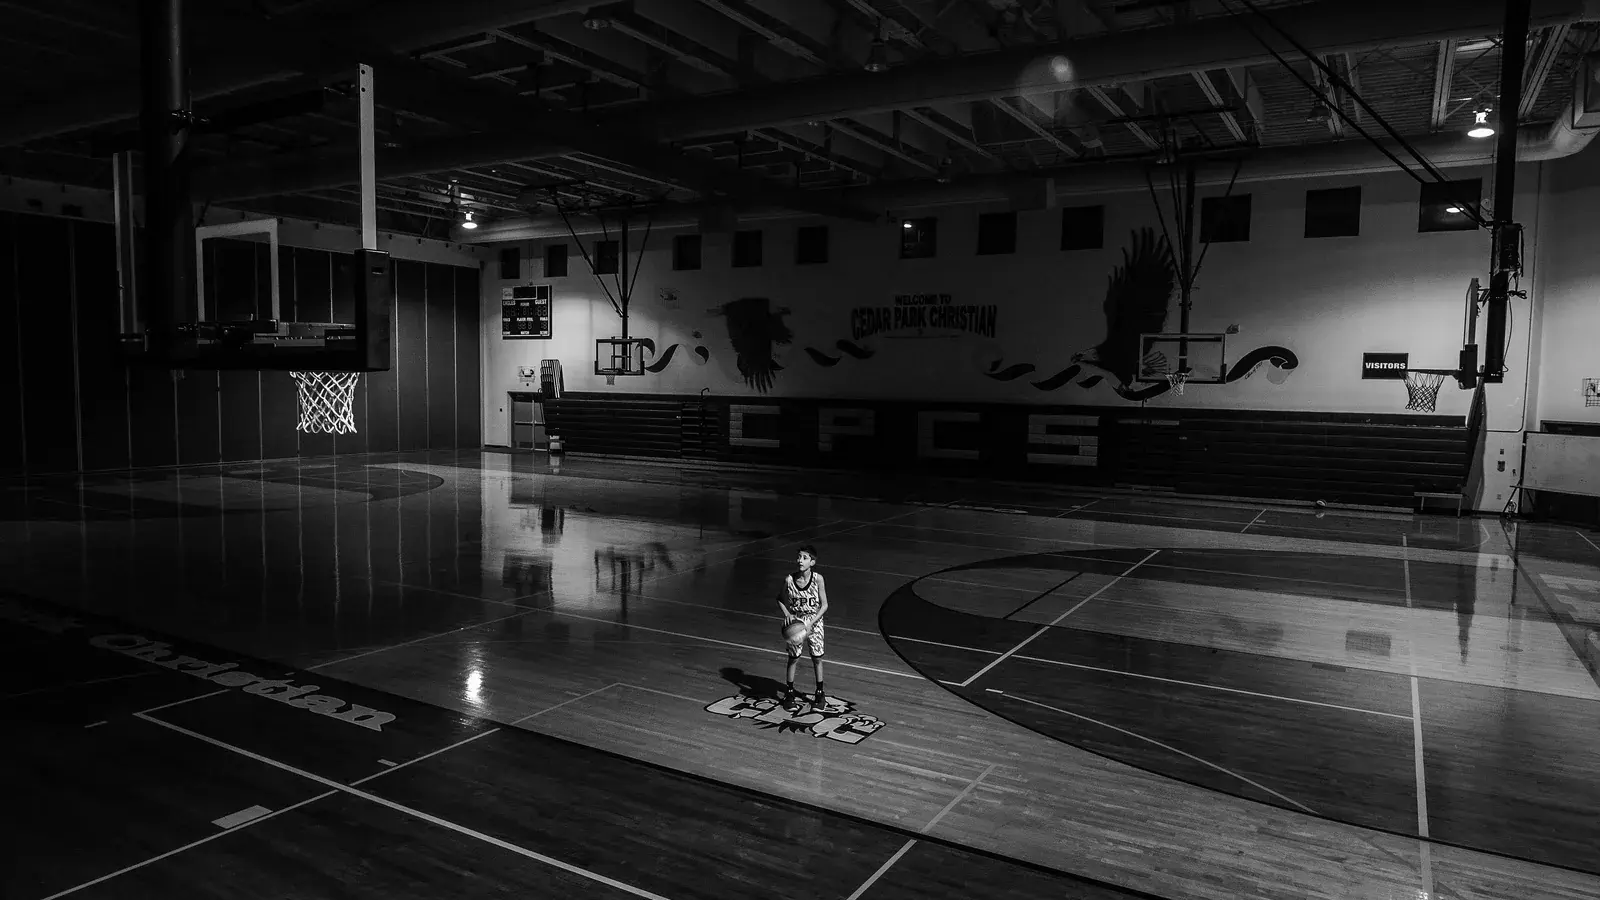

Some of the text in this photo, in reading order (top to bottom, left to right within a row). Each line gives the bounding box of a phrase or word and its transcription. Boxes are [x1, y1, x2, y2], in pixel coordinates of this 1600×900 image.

[894, 293, 952, 305] WELCOME TO
[851, 304, 997, 340] CEDAR PARK CHRISTIAN
[1365, 362, 1406, 370] VISITORS
[704, 693, 887, 744] CPC
